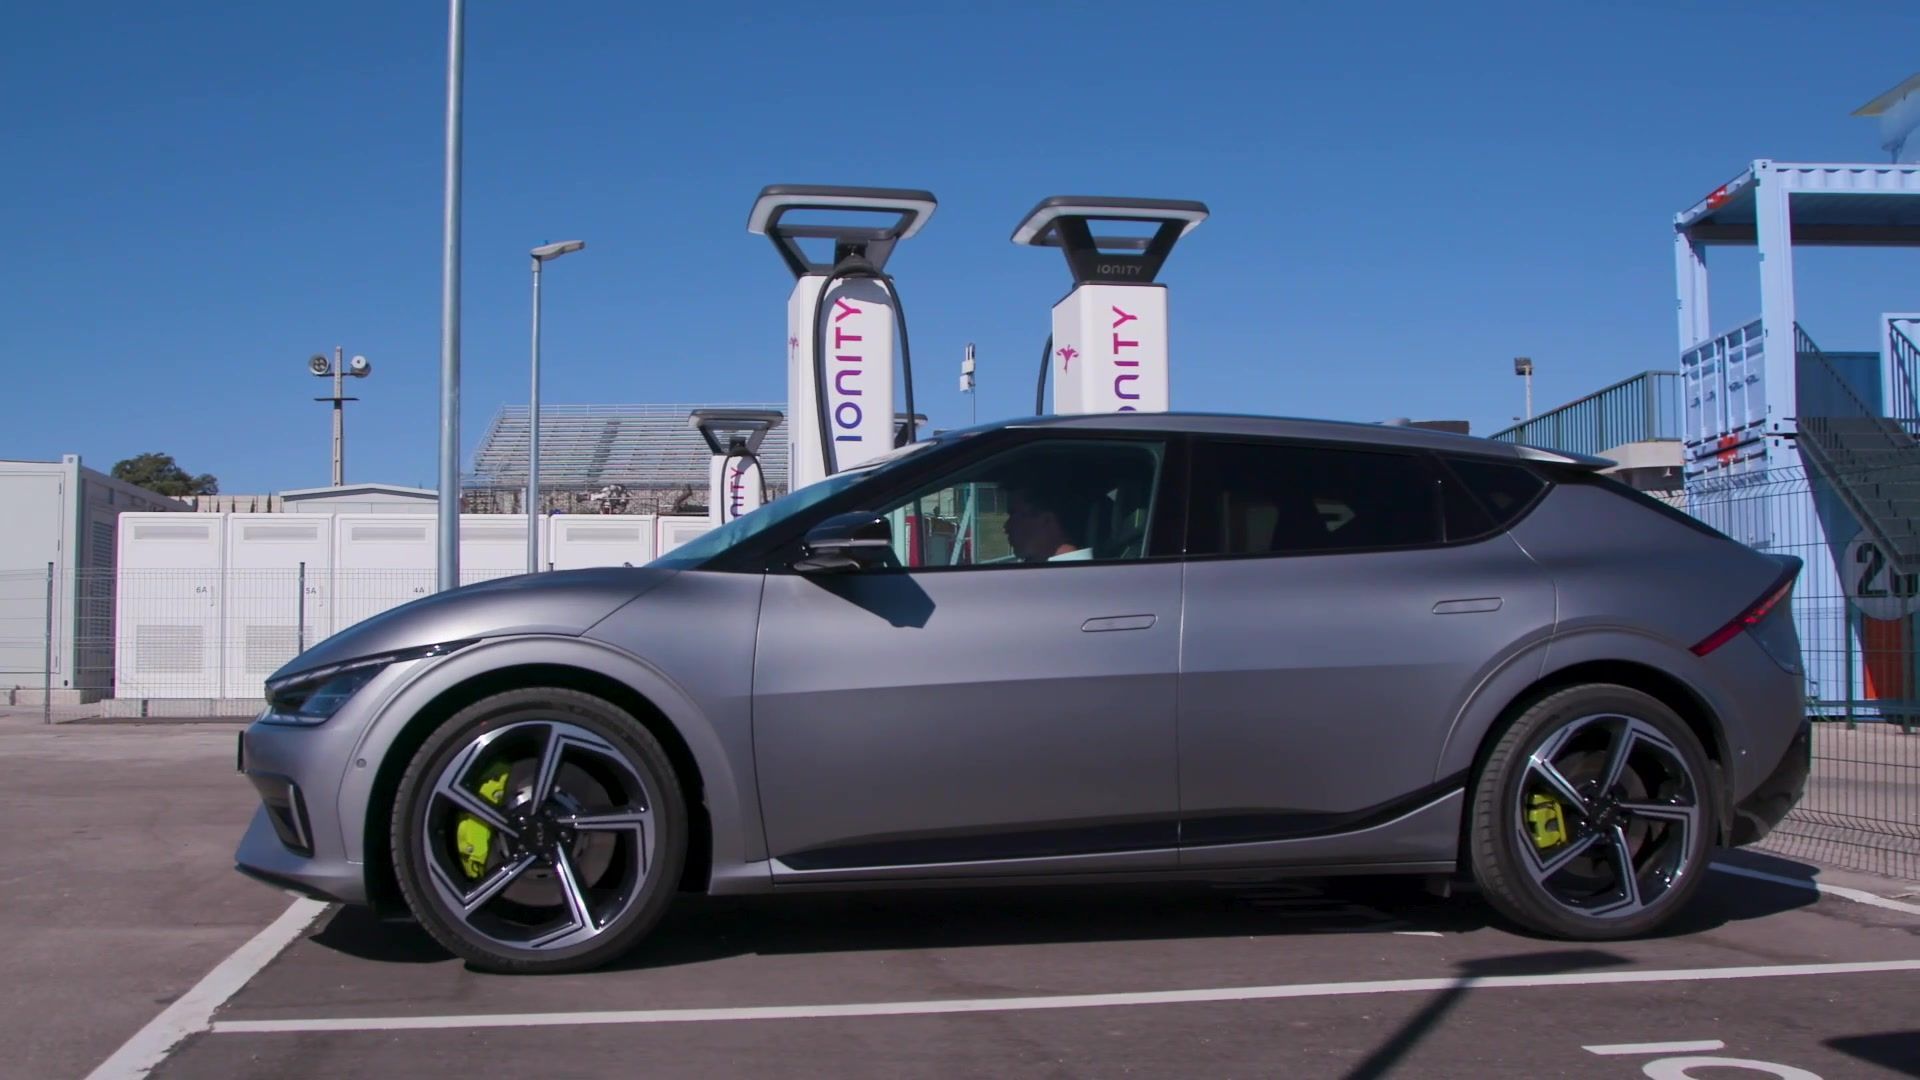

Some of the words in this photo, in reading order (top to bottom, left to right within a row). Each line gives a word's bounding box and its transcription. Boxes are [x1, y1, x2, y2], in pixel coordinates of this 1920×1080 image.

[834, 298, 863, 442] IONITY
[1112, 305, 1140, 411] NITY
[730, 467, 745, 517] NITY
